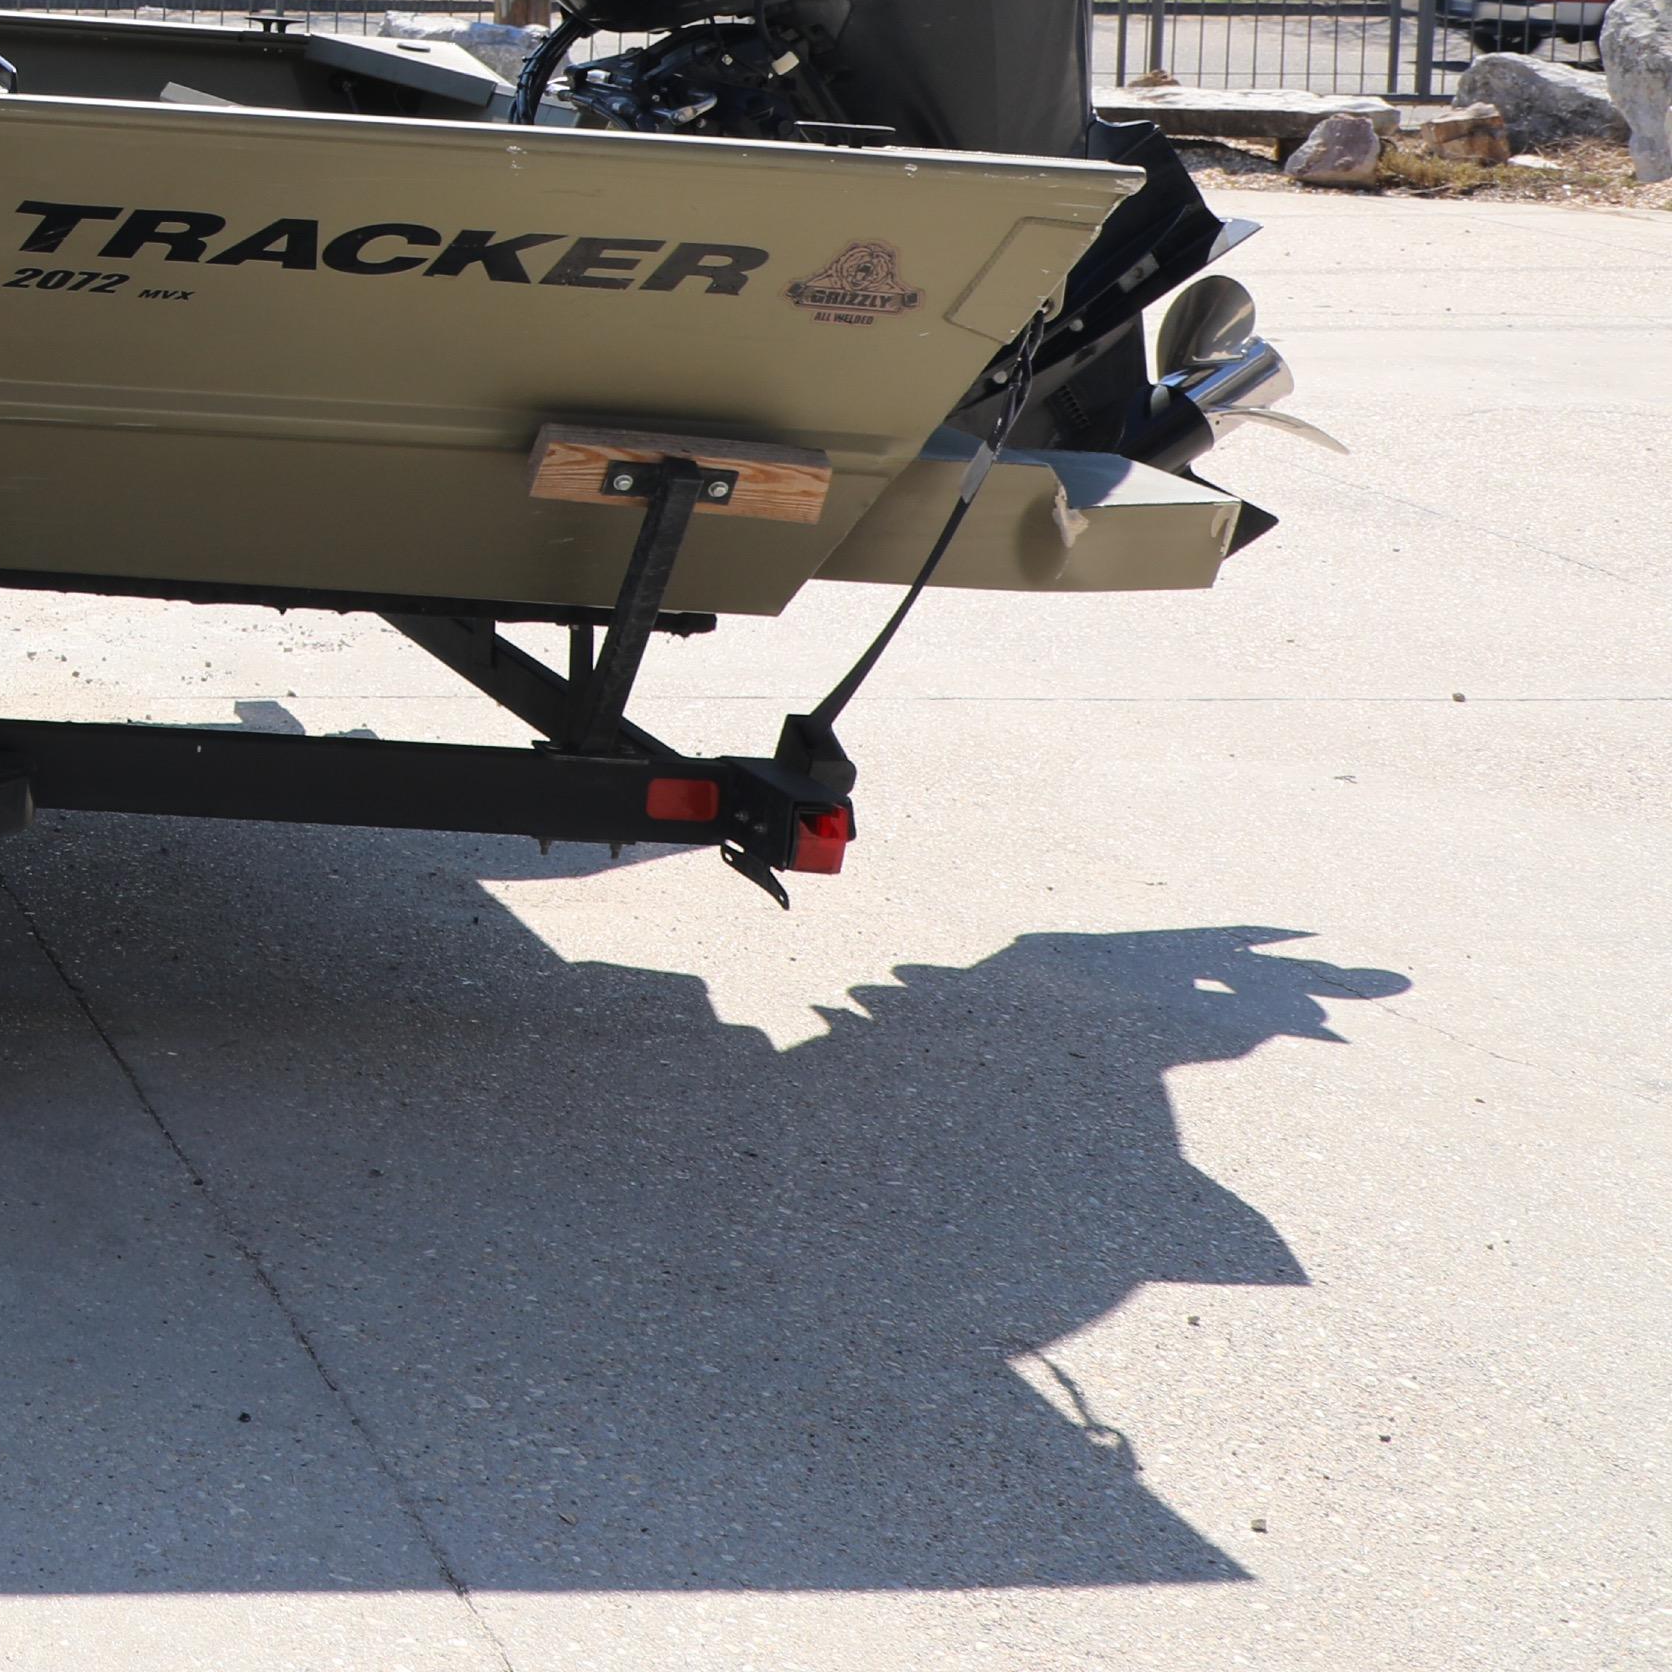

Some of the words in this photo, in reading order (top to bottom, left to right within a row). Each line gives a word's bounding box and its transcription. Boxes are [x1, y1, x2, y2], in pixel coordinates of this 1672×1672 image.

[14, 200, 769, 296] TRACKER
[1, 267, 131, 294] 2072
[137, 289, 196, 301] MVX
[810, 289, 893, 309] GRIZZLY
[814, 311, 832, 322] ALL
[833, 312, 875, 326] WELDED
